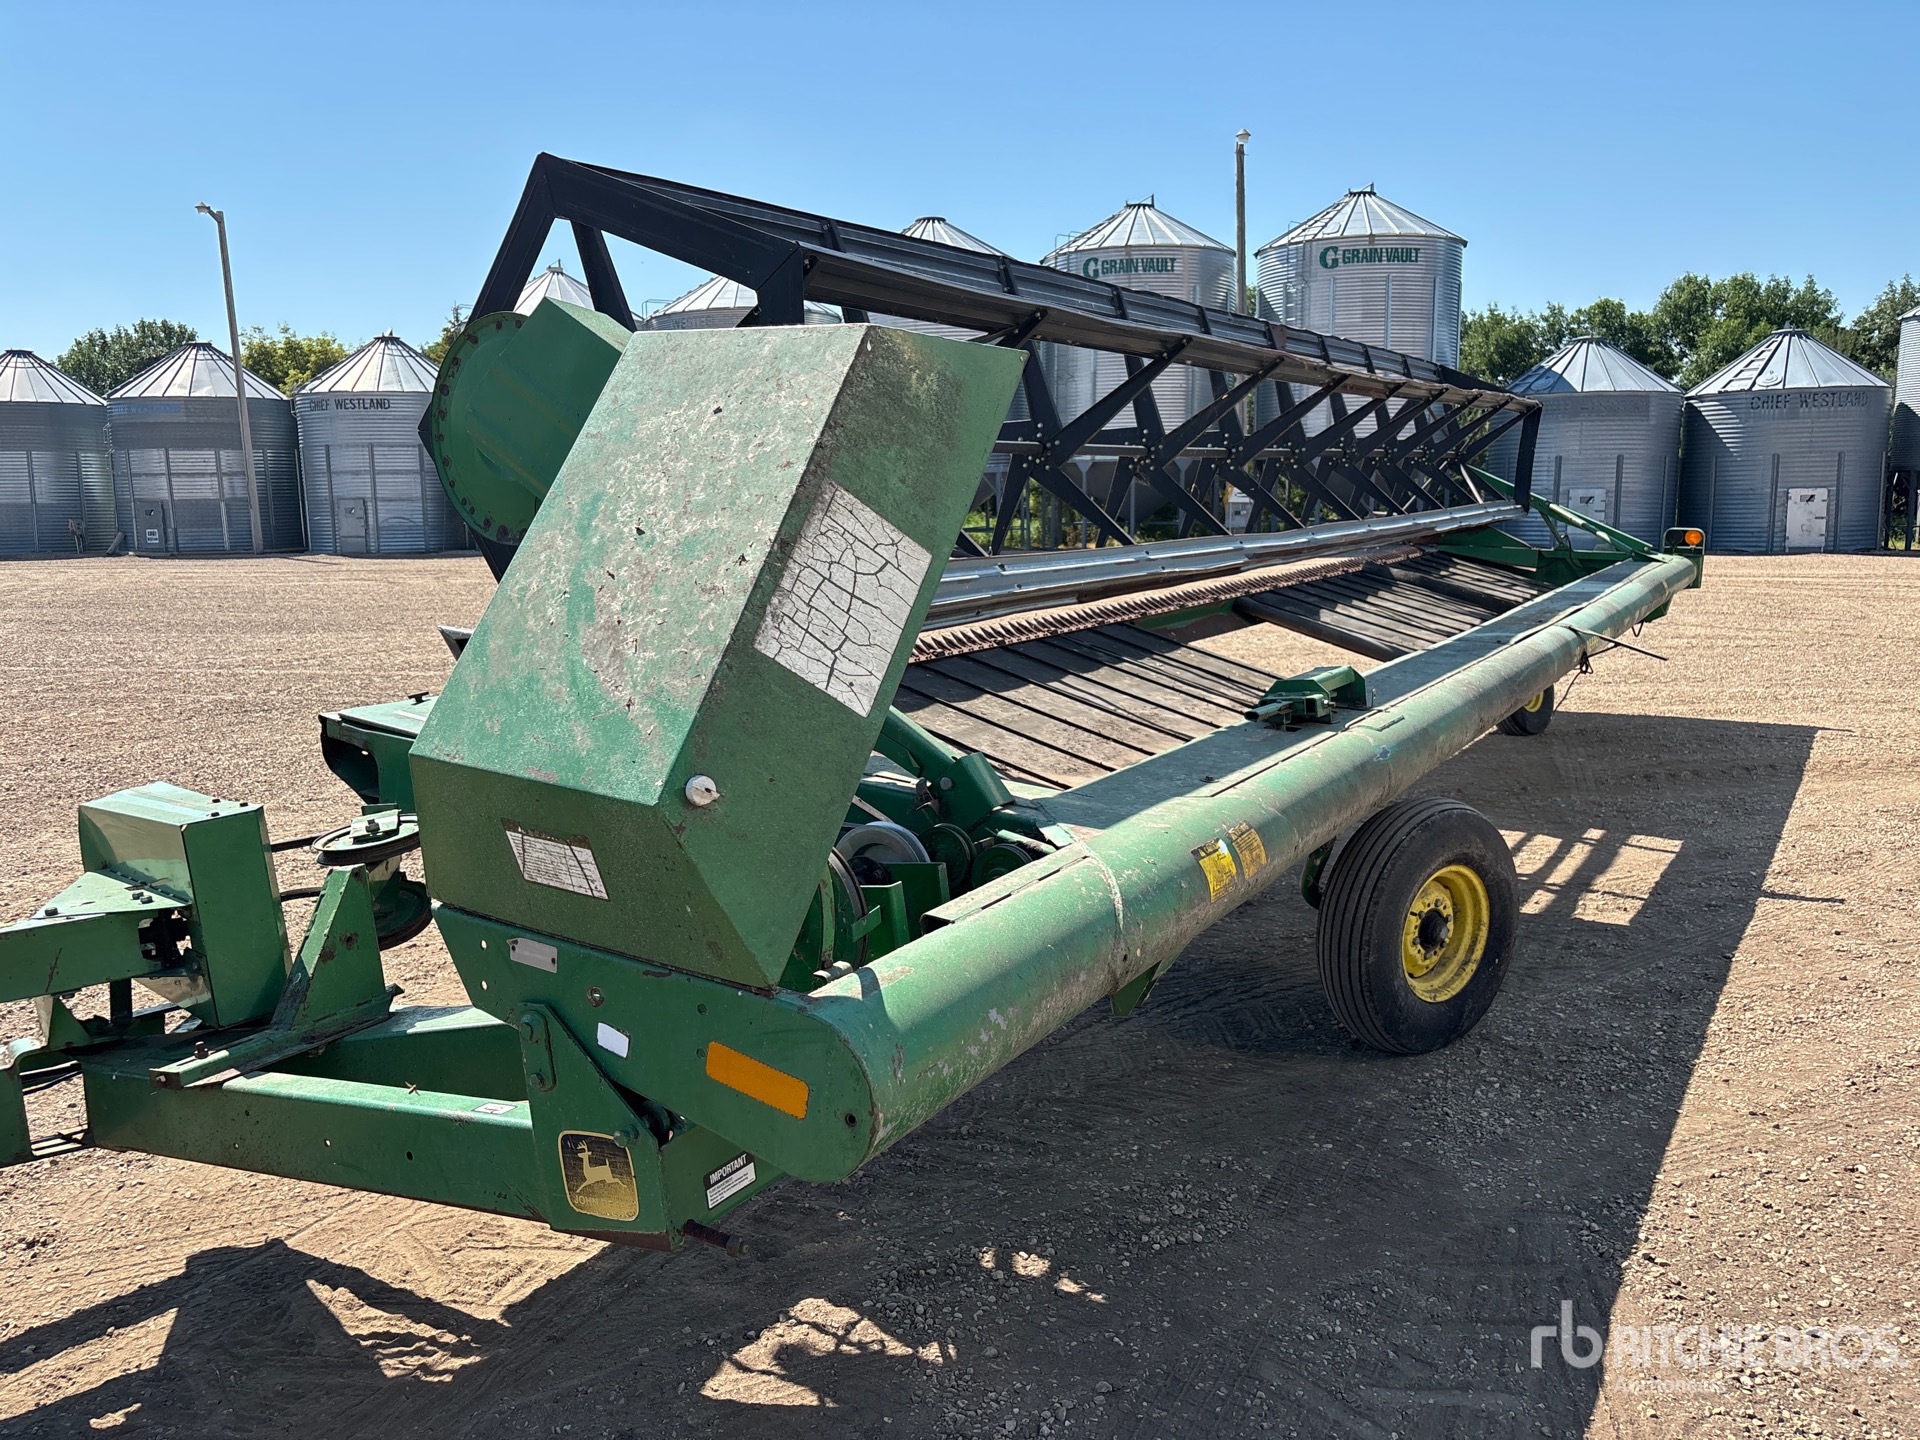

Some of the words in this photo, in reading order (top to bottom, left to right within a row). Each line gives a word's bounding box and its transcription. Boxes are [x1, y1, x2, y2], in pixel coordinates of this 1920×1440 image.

[1342, 248, 1383, 264] GRAIN
[1383, 247, 1421, 263] VAULT
[1101, 258, 1138, 275] GRAIN
[1140, 257, 1176, 273] VAULT
[309, 399, 330, 412] CHIEF
[334, 398, 391, 410] WESTLAND
[1750, 394, 1791, 410] CHIEF
[1800, 391, 1869, 408] WESTLAND
[709, 1153, 747, 1185] IMPORTANT
[574, 1194, 599, 1206] JOHN
